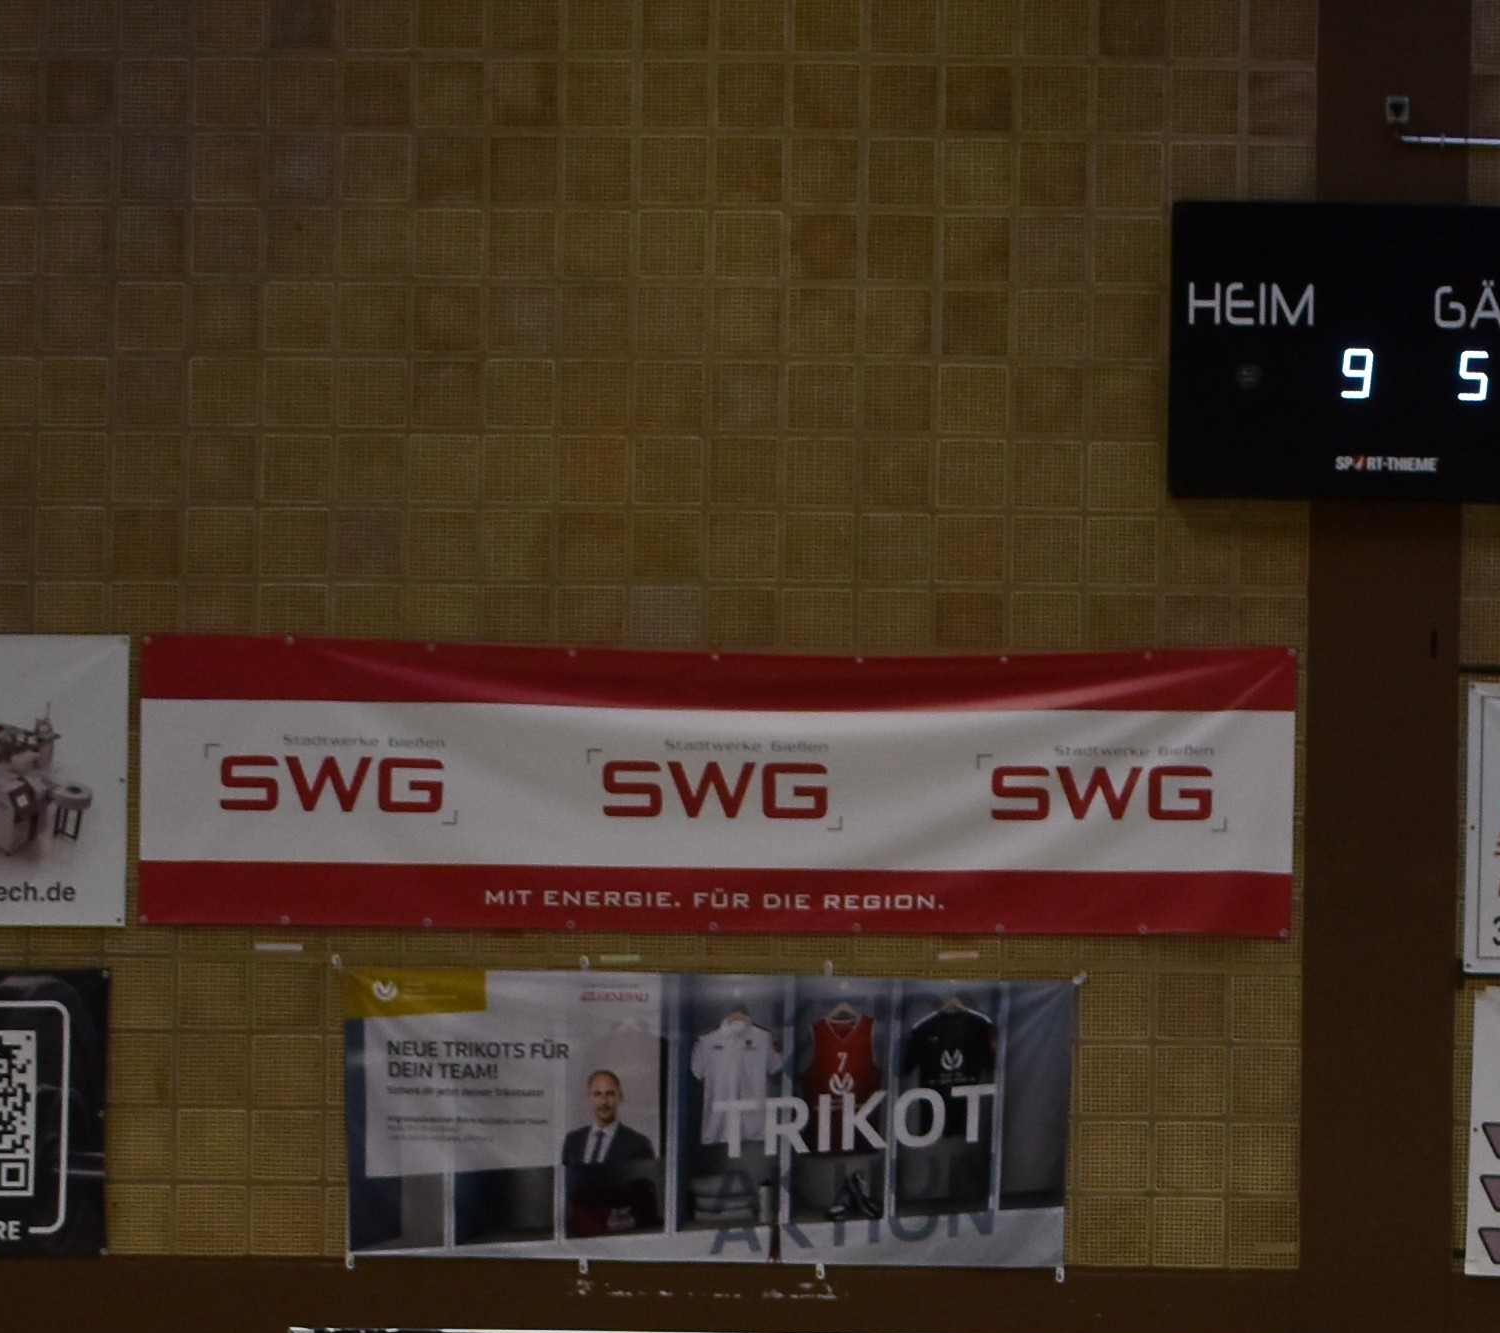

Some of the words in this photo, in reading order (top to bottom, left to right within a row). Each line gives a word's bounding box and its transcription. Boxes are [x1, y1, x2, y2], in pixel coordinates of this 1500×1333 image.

[1187, 281, 1315, 327] HEIM
[1340, 347, 1374, 400] 9
[1458, 350, 1490, 402] 5
[220, 755, 444, 813] SWG
[602, 760, 828, 819] SWG
[991, 765, 1213, 821] SWG
[484, 889, 532, 907] MIT
[543, 889, 681, 909] ENERGIE.
[692, 887, 750, 910] FÜR
[763, 892, 811, 910] DIE
[823, 893, 945, 912] REGION.
[387, 1040, 438, 1058] NEUE
[442, 1040, 525, 1059] TRIKOTS
[530, 1039, 569, 1060] FÜR
[387, 1061, 433, 1079] DEIN
[438, 1062, 499, 1080] TEAM!
[712, 1083, 997, 1159] TRIKOT
